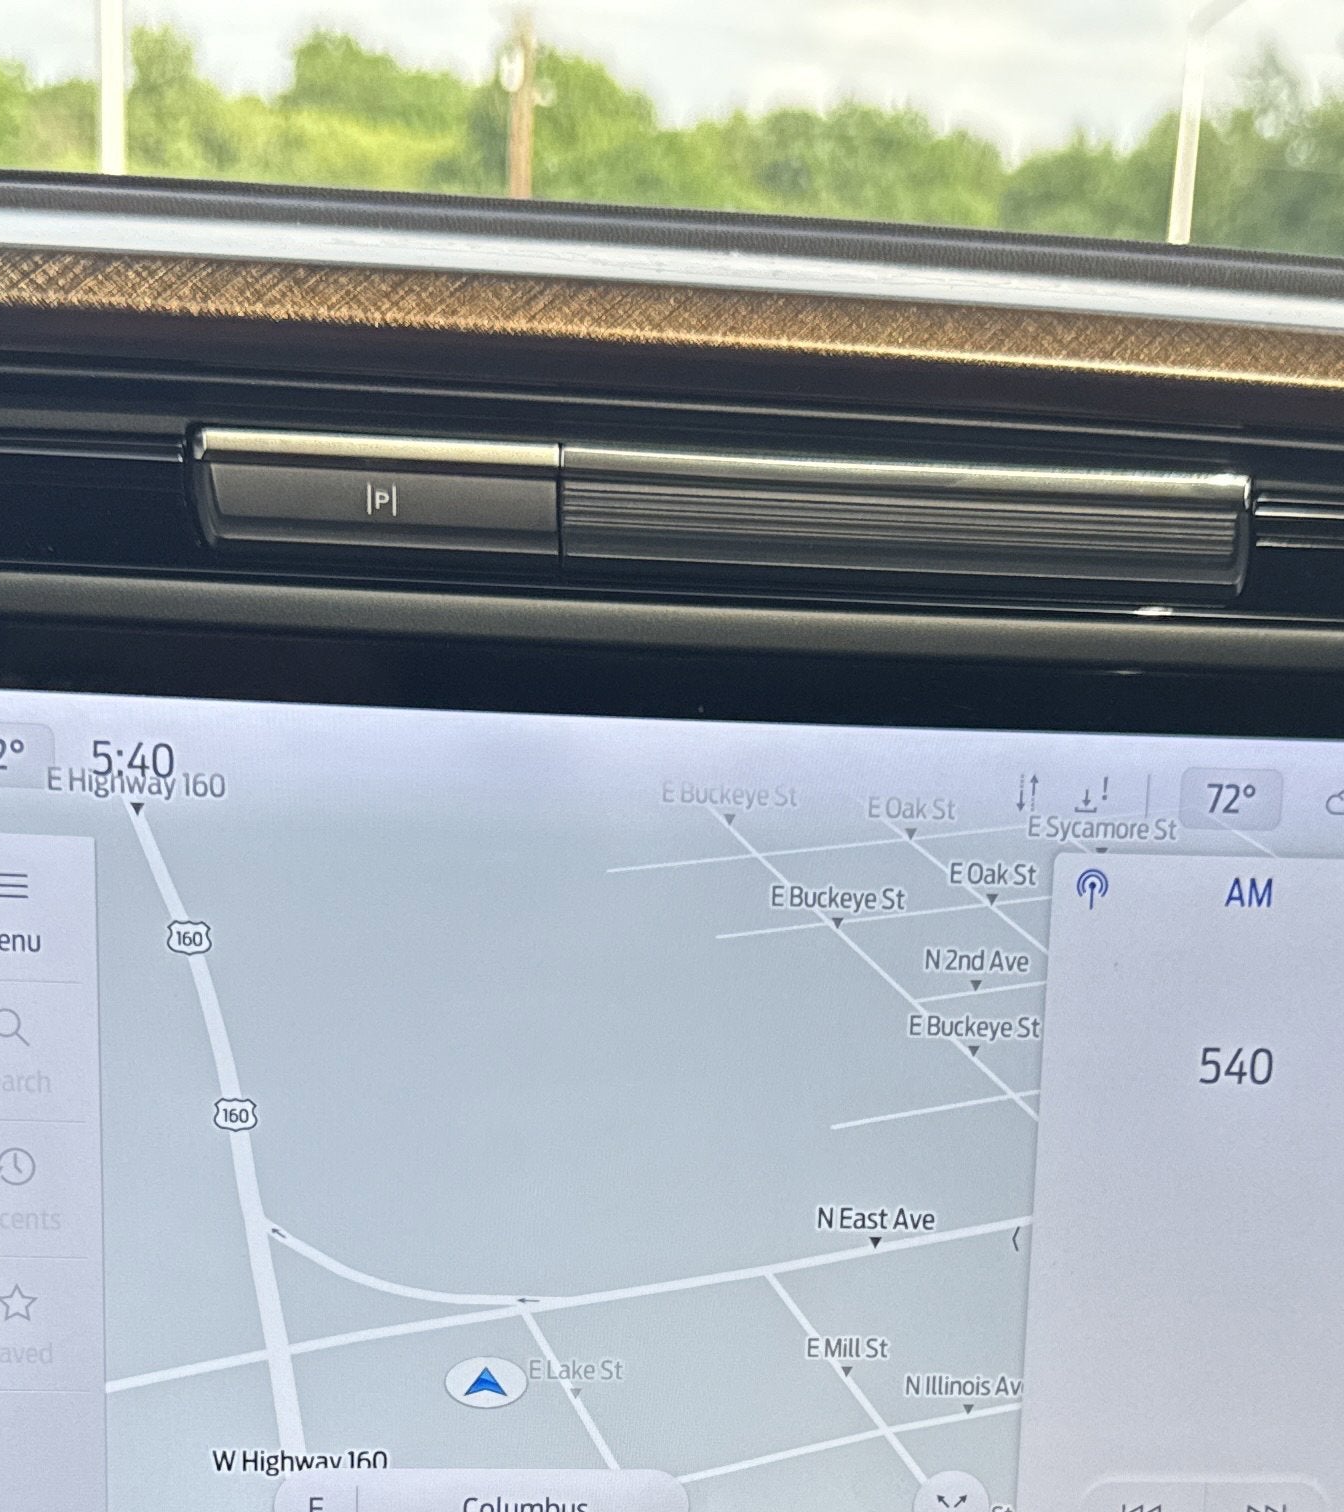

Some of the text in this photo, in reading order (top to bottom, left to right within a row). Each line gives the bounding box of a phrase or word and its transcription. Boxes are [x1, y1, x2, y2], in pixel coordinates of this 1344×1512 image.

[90, 739, 175, 778] 5:40
[46, 767, 226, 800] E Highway 160
[662, 780, 798, 810] E Buckeye St
[868, 796, 956, 821] E Oak St
[1206, 783, 1256, 814] 72°
[1028, 815, 1177, 842] E Sycamore St
[949, 863, 1037, 887] E Oak St
[771, 886, 906, 914] E Buckeye St
[1225, 877, 1274, 907] AM
[175, 930, 203, 947] 160
[924, 949, 1030, 972] N 2nd Ave
[909, 1015, 1040, 1042] E Buckeye St
[1198, 1047, 1274, 1085] 540
[221, 1107, 250, 1124] 160
[817, 1206, 936, 1231] N East Ave
[807, 1337, 889, 1359] E Mill St
[529, 1360, 623, 1381] E Lake St
[905, 1376, 921, 1396] N
[925, 1375, 991, 1397] Illinois
[211, 1450, 237, 1472] W
[347, 1450, 388, 1469] 160
